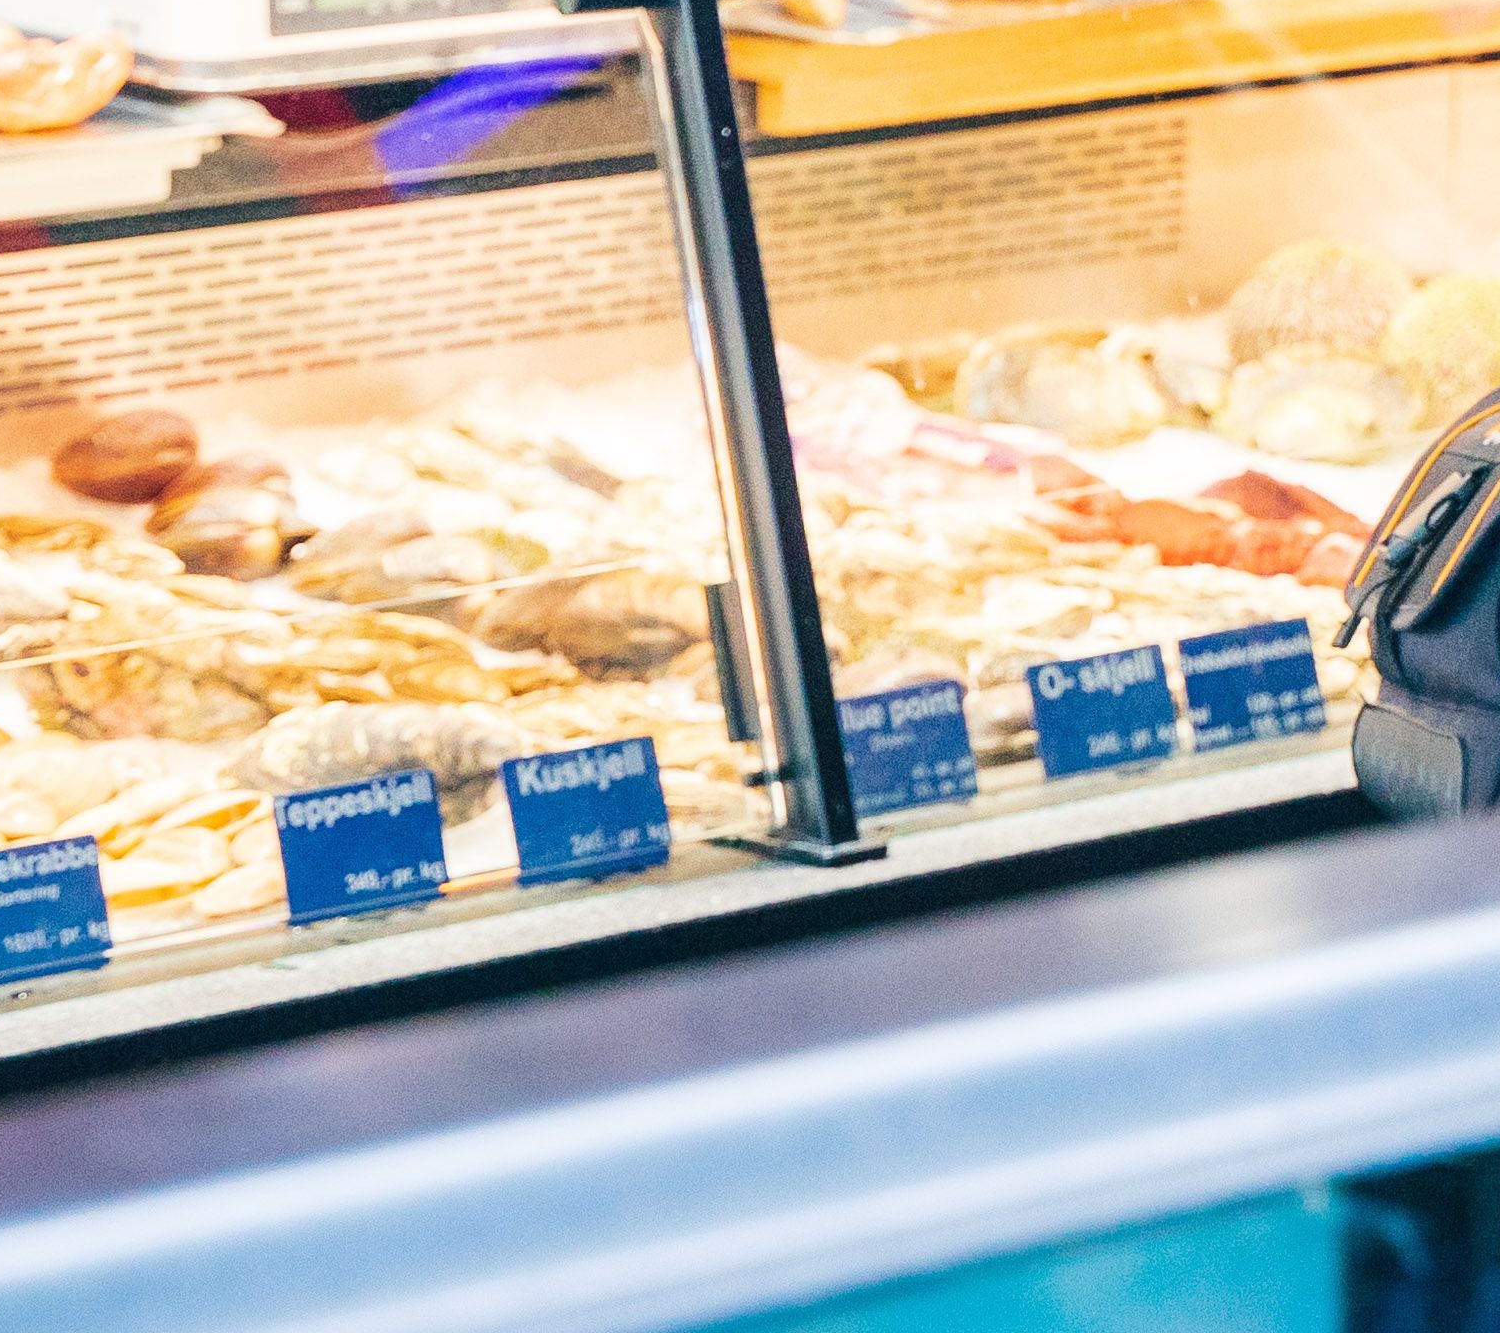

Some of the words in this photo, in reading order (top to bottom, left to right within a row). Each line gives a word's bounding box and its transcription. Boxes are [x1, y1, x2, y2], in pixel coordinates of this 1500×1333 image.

[839, 703, 886, 733] lue
[516, 741, 646, 797] Kuskjell
[274, 773, 434, 830] Teppeskjell
[419, 861, 447, 882] kg
